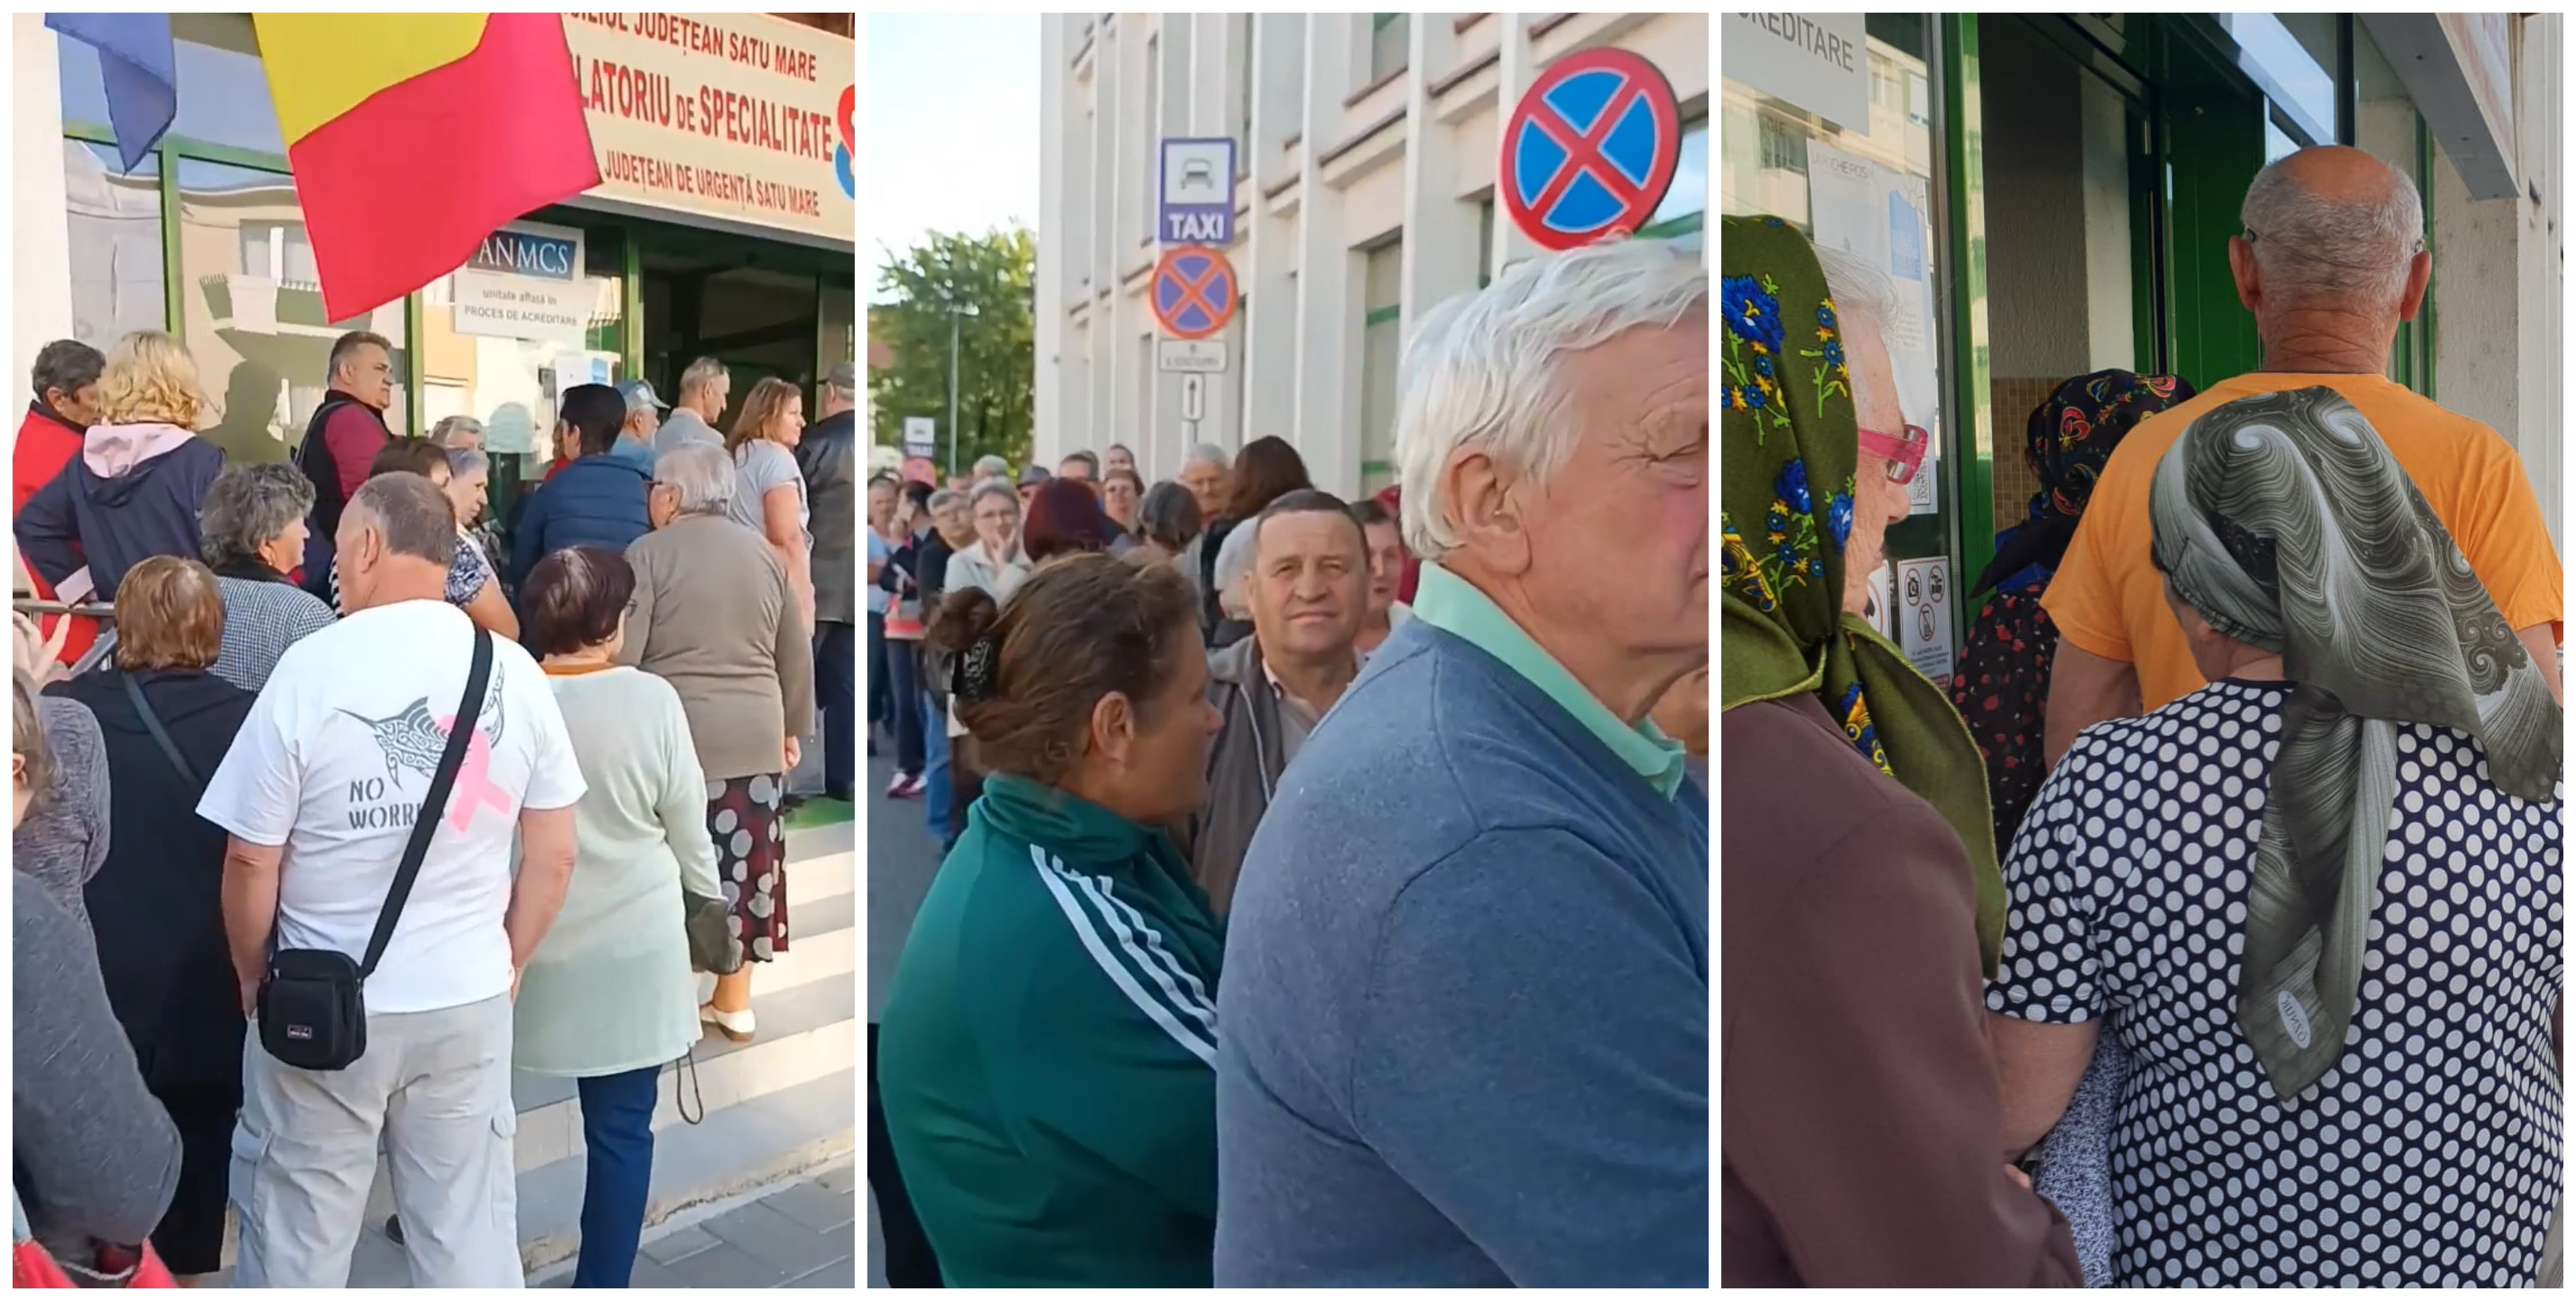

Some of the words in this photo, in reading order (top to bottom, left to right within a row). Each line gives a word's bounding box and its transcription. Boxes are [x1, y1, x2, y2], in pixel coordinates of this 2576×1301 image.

[634, 13, 724, 58] JUDEȚEAN
[729, 32, 769, 69] SATU
[776, 45, 816, 82] MARE
[1738, 13, 1854, 73] EDITARE
[676, 94, 696, 133] DE
[700, 84, 833, 163] SPECIALITATE
[605, 150, 673, 192] JUDEȚEAN
[676, 163, 693, 193] DE
[757, 178, 786, 210] SATU
[789, 186, 820, 217] MARE
[1169, 212, 1224, 240] TAXI
[477, 237, 568, 275] ANMCS
[464, 305, 504, 320] PROCES
[507, 308, 519, 320] DE
[521, 310, 578, 327] ACREDITARE
[350, 777, 384, 803] NO
